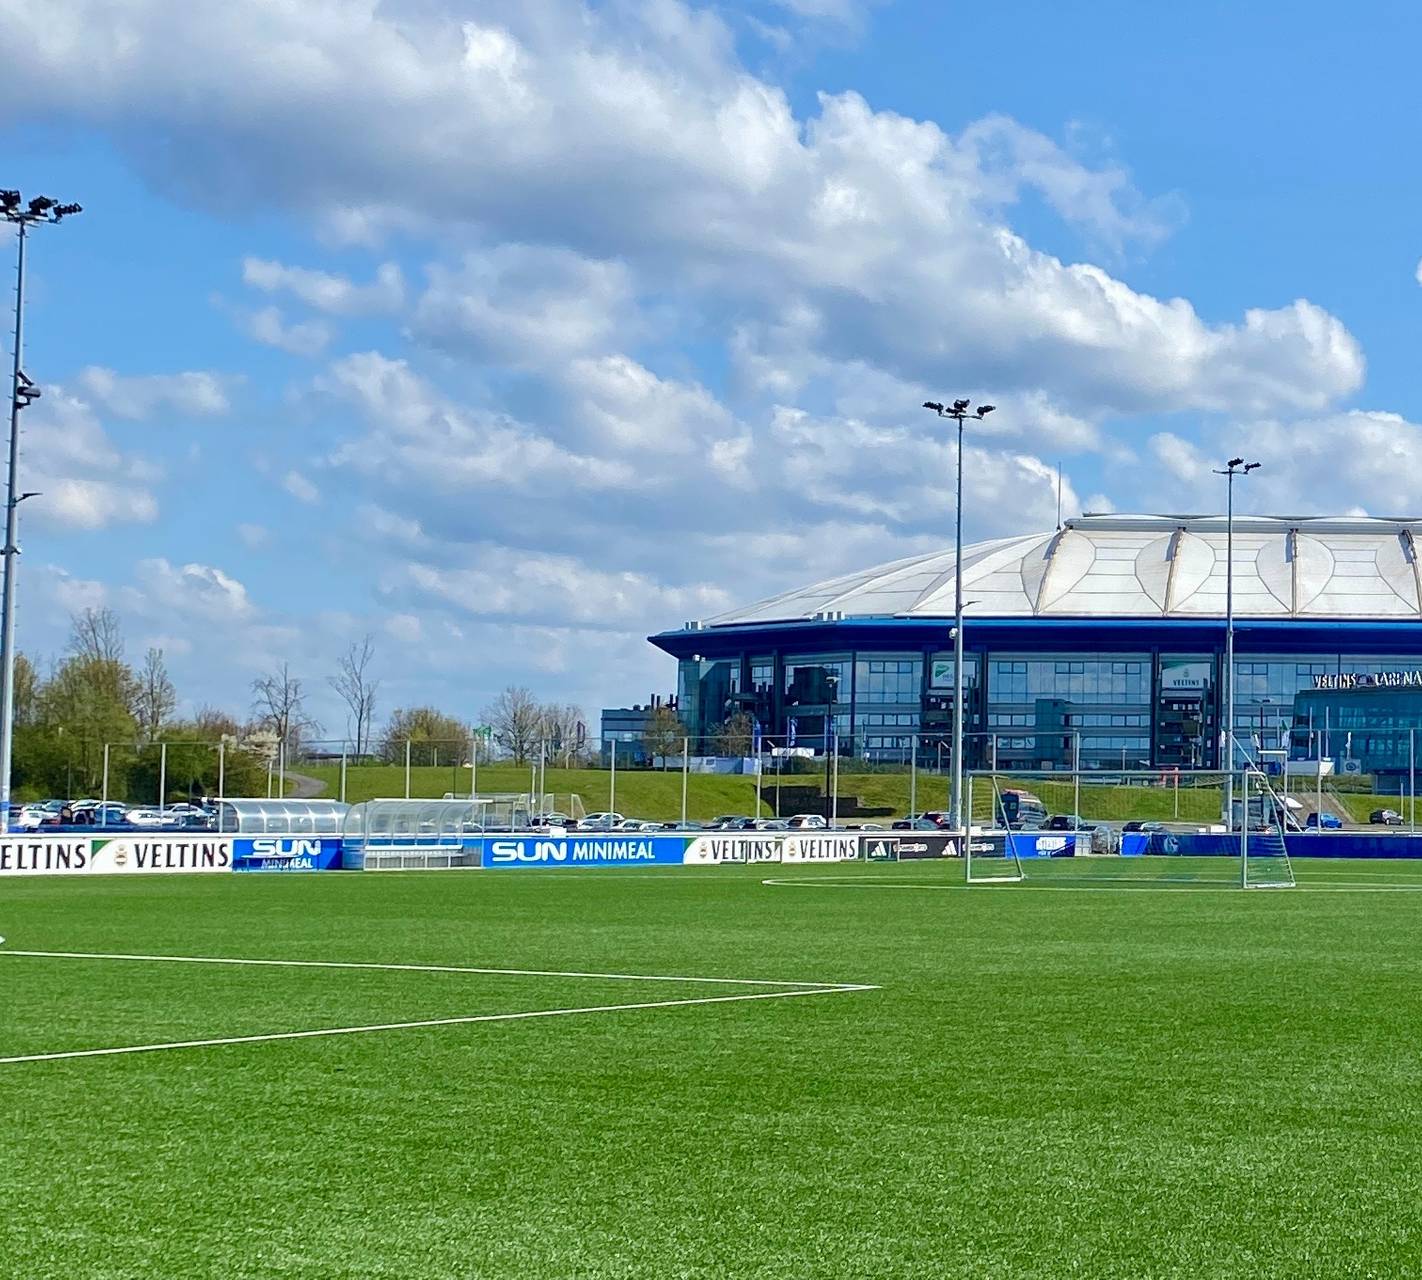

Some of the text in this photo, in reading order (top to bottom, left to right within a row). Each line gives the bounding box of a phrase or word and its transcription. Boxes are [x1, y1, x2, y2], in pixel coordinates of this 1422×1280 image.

[134, 843, 229, 868] VELTINS
[252, 838, 322, 856] SUN
[491, 840, 655, 862] SUN MINIMEAL
[711, 840, 773, 859] VELTINS
[800, 839, 855, 858] VELTINS
